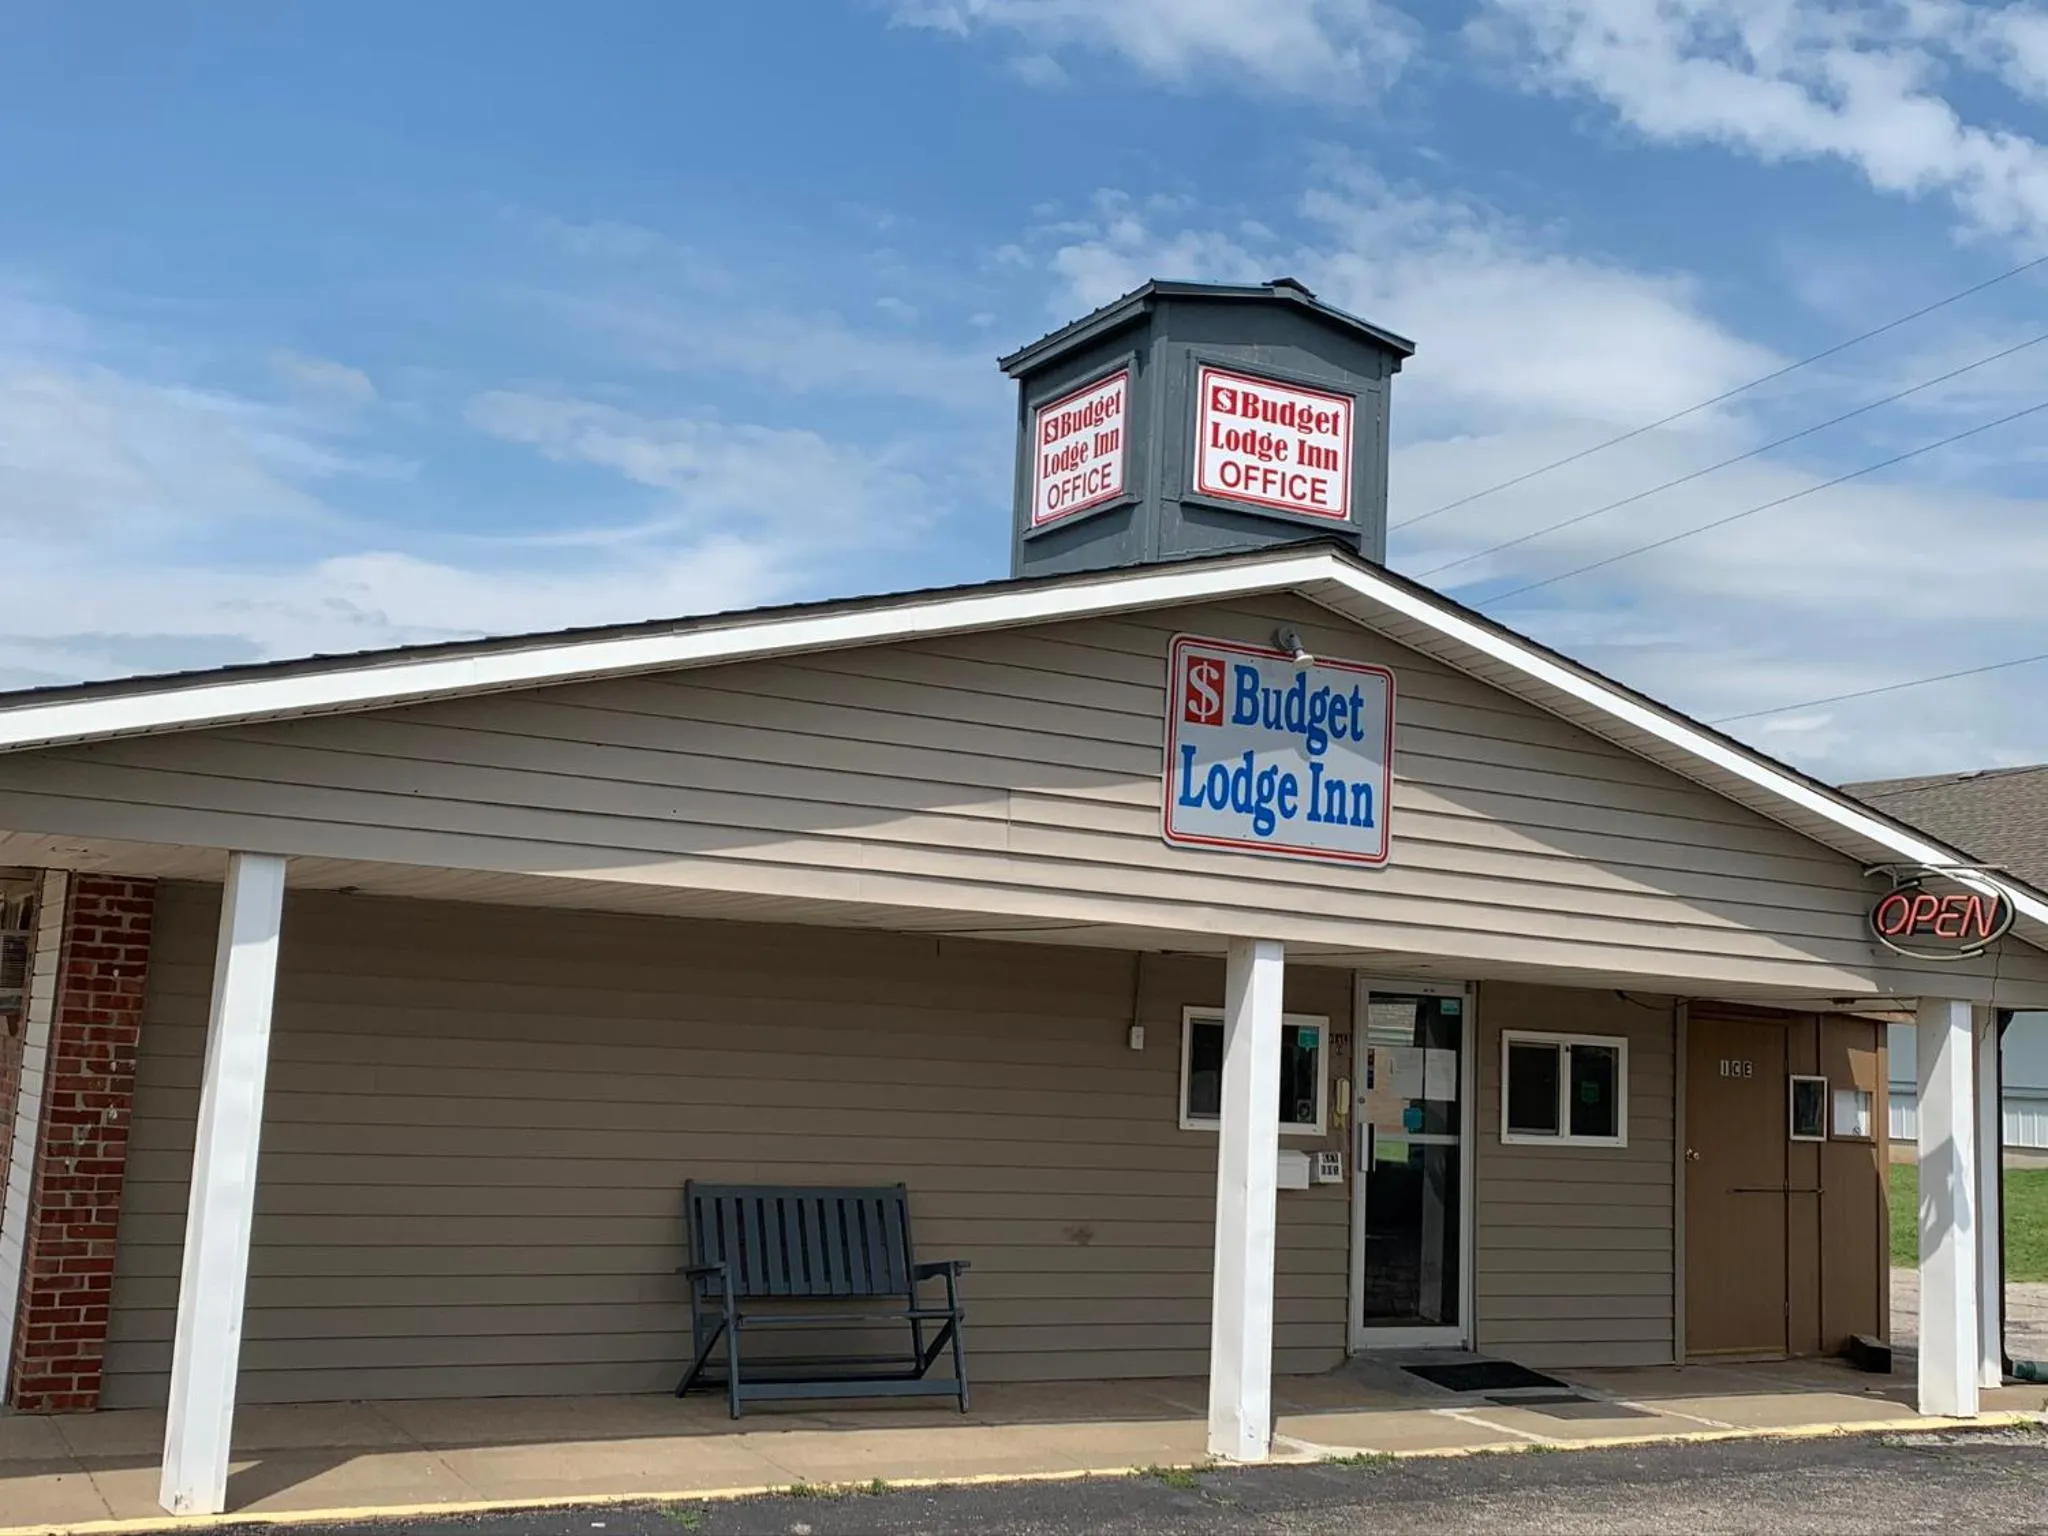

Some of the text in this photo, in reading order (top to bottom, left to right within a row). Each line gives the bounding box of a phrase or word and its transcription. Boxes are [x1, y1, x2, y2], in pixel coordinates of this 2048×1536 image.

[1060, 388, 1122, 439] Budget
[1241, 391, 1341, 437] Budget
[1042, 427, 1120, 480] Lodge Inn
[1210, 421, 1339, 472] Lodge Inn
[1047, 462, 1113, 511] OFFICE
[1220, 460, 1328, 505] OFFICE
[1231, 664, 1365, 756] Budget
[1178, 744, 1375, 838] Lodge Inn
[1877, 895, 1999, 937] OPEN
[1721, 1060, 1752, 1077] ICE
